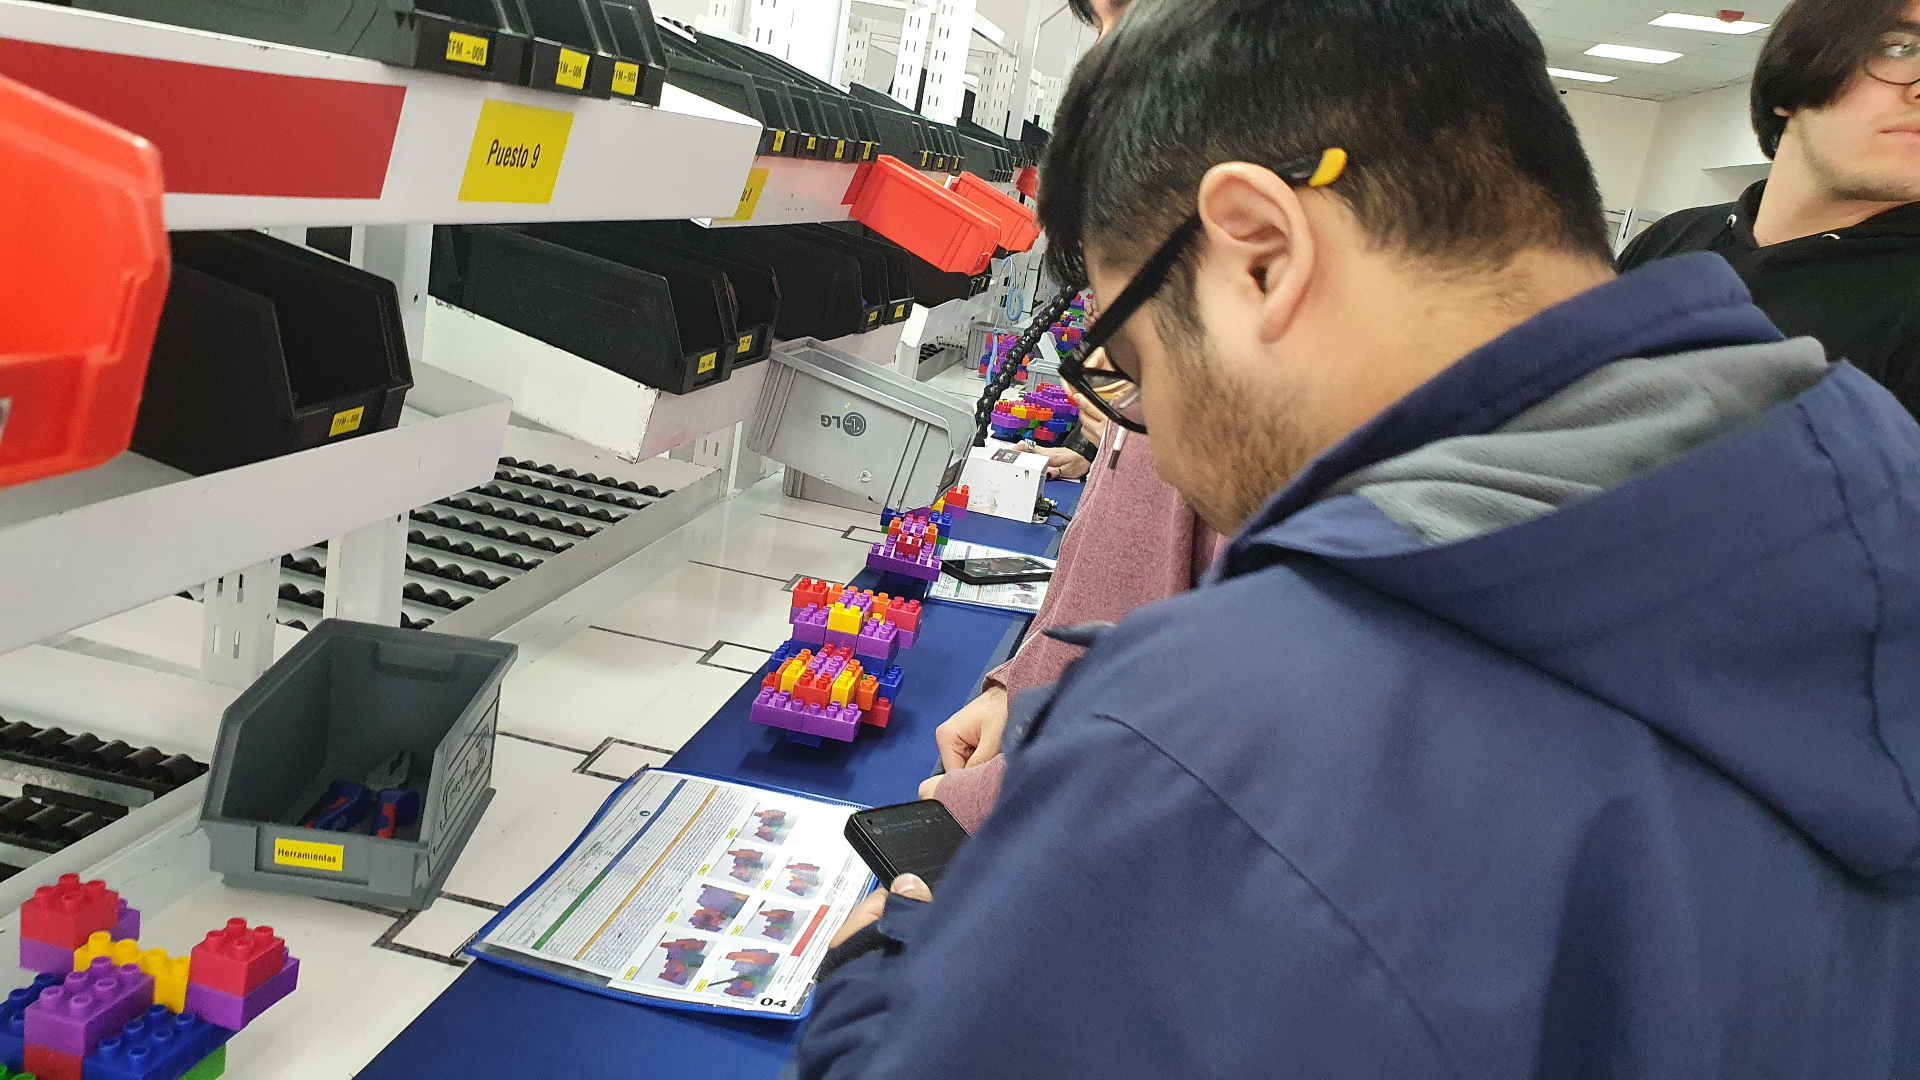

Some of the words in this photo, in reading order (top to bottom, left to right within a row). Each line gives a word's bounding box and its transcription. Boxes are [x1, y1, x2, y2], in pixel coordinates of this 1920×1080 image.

[486, 138, 529, 168] Puesto
[530, 143, 541, 169] 9
[820, 414, 841, 429] LG
[277, 846, 337, 864] Herramientas
[760, 997, 787, 1008] 04
